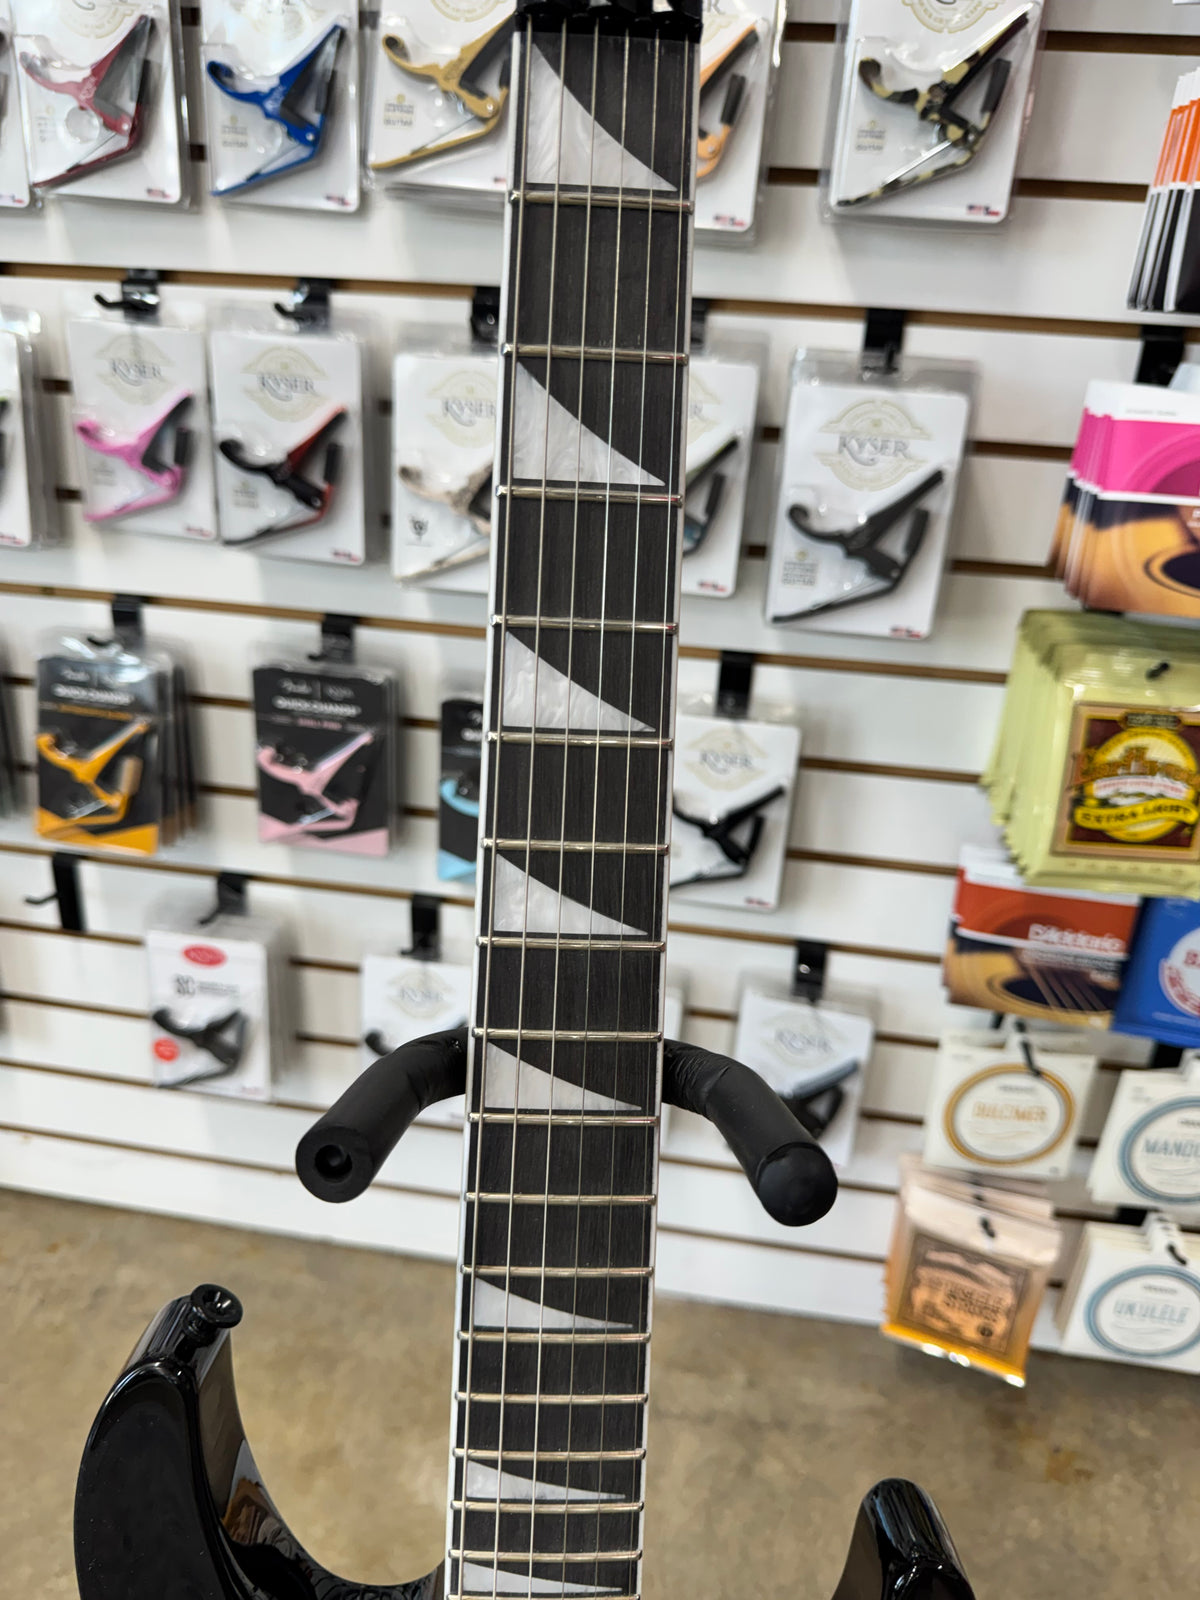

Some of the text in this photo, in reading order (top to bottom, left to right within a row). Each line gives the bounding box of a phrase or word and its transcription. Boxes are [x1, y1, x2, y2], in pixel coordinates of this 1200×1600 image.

[257, 371, 318, 402] KYSER
[838, 432, 911, 466] KYSER
[1113, 1300, 1190, 1324] UKULELE
